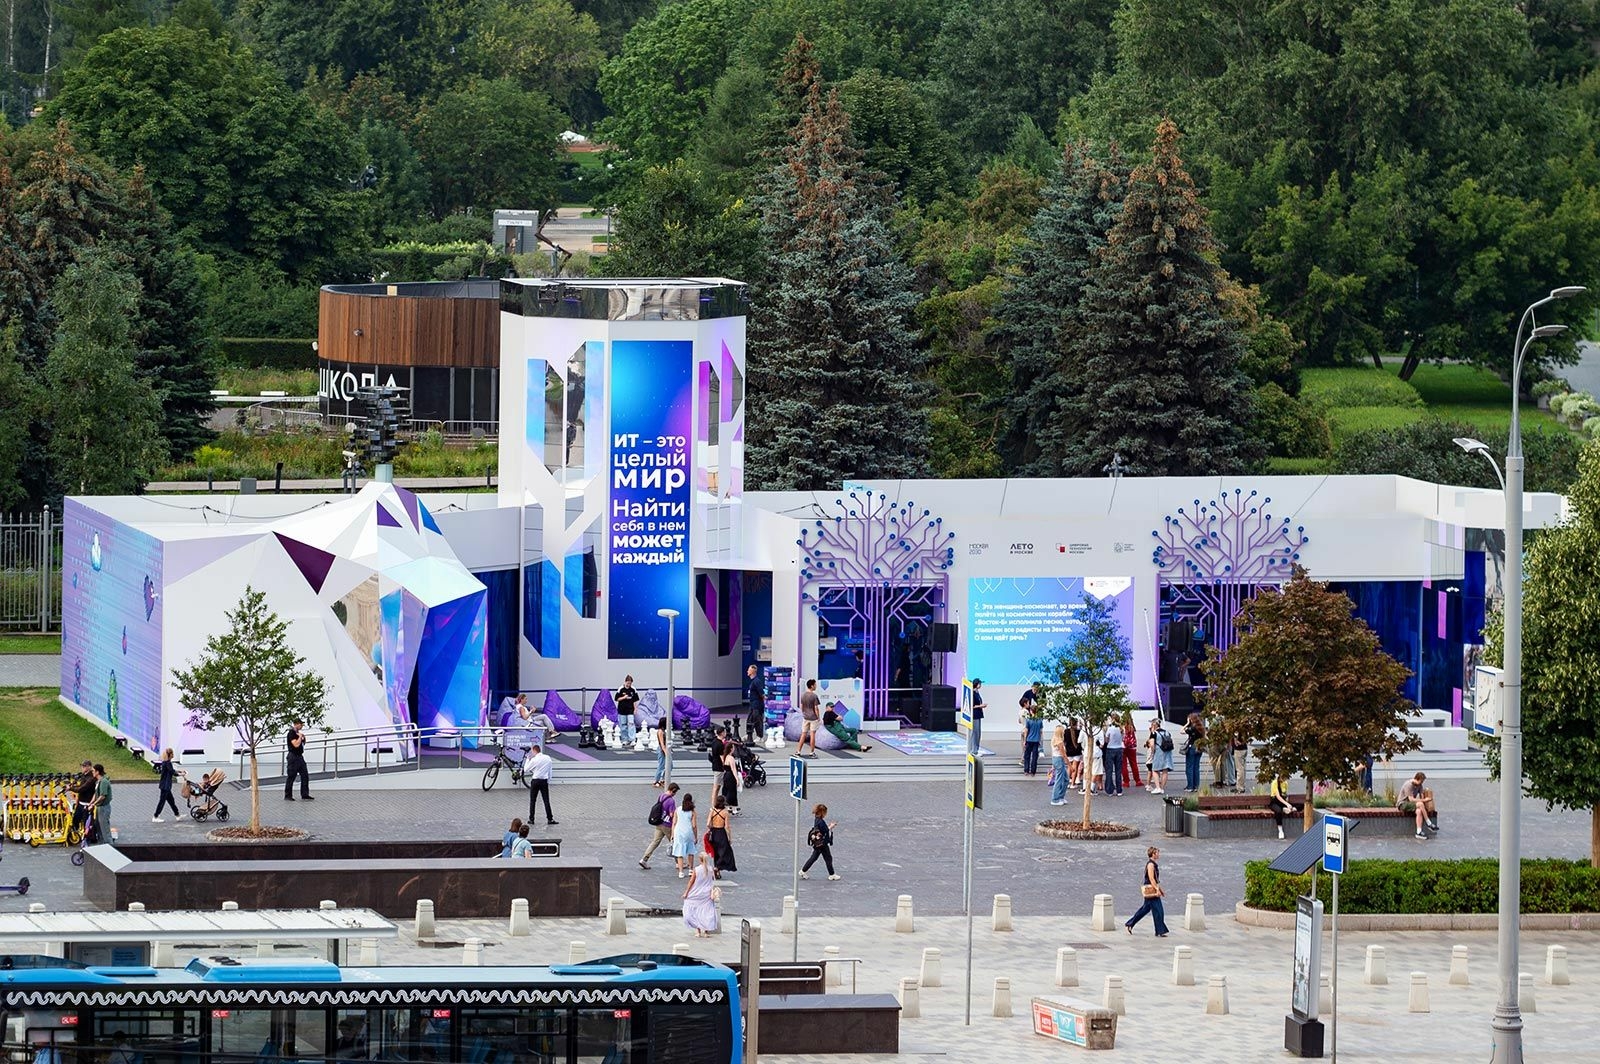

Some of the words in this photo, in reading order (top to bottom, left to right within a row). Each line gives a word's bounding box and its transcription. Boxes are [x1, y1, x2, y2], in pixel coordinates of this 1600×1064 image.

[614, 433, 639, 448] ИТ
[656, 435, 686, 448] это
[614, 448, 686, 470] целый
[614, 468, 686, 495] мир
[613, 497, 685, 518] Найти
[612, 519, 644, 532] себя
[647, 522, 656, 531] в
[659, 521, 686, 531] нем
[613, 533, 685, 549] может
[612, 548, 685, 566] каждый
